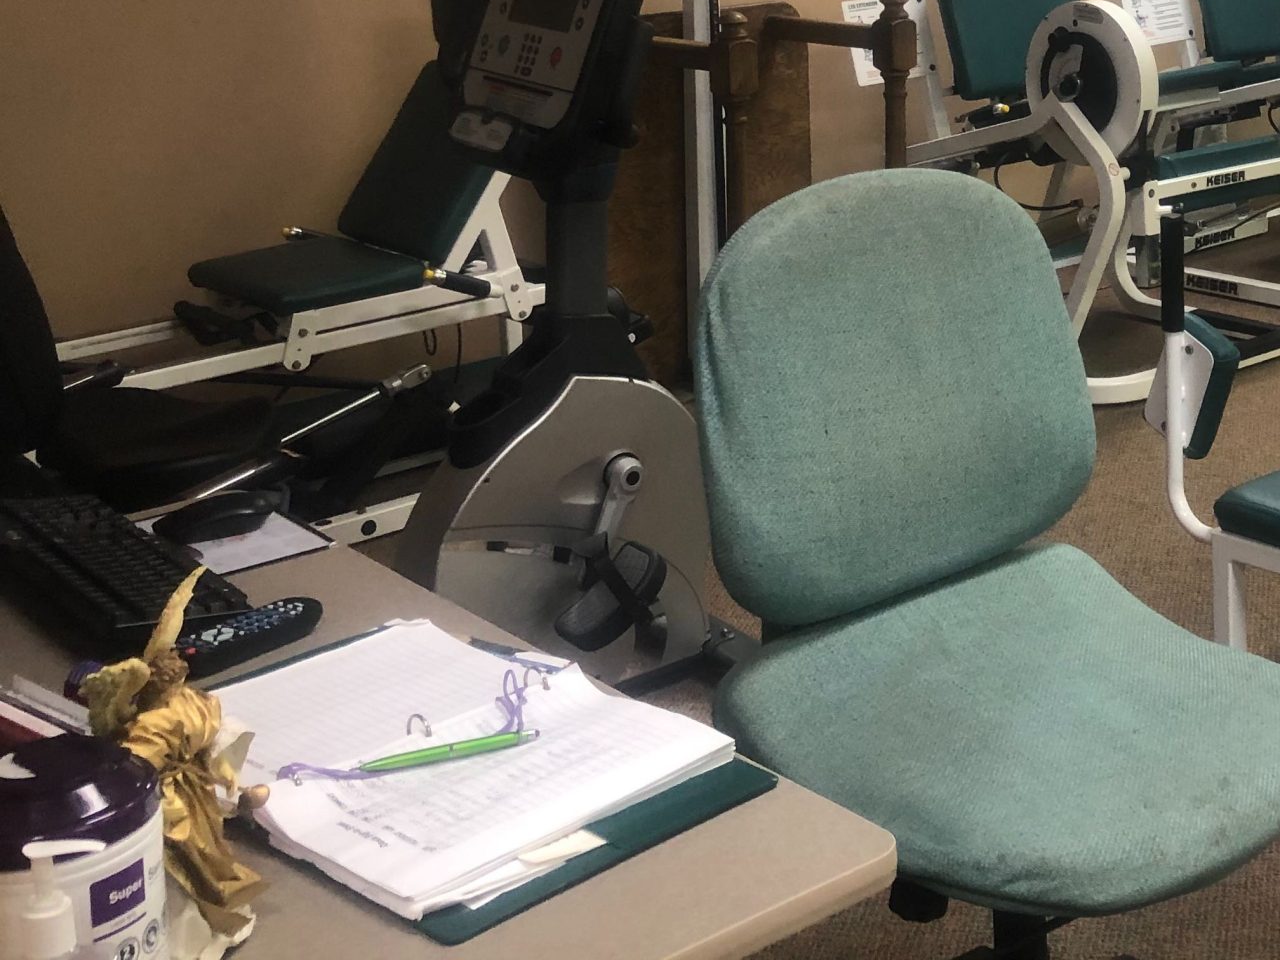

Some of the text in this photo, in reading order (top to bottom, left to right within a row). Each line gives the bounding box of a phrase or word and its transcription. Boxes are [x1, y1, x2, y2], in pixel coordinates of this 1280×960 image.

[1206, 171, 1245, 187] KEISER
[1186, 274, 1238, 296] KEISER
[109, 879, 142, 905] Super
